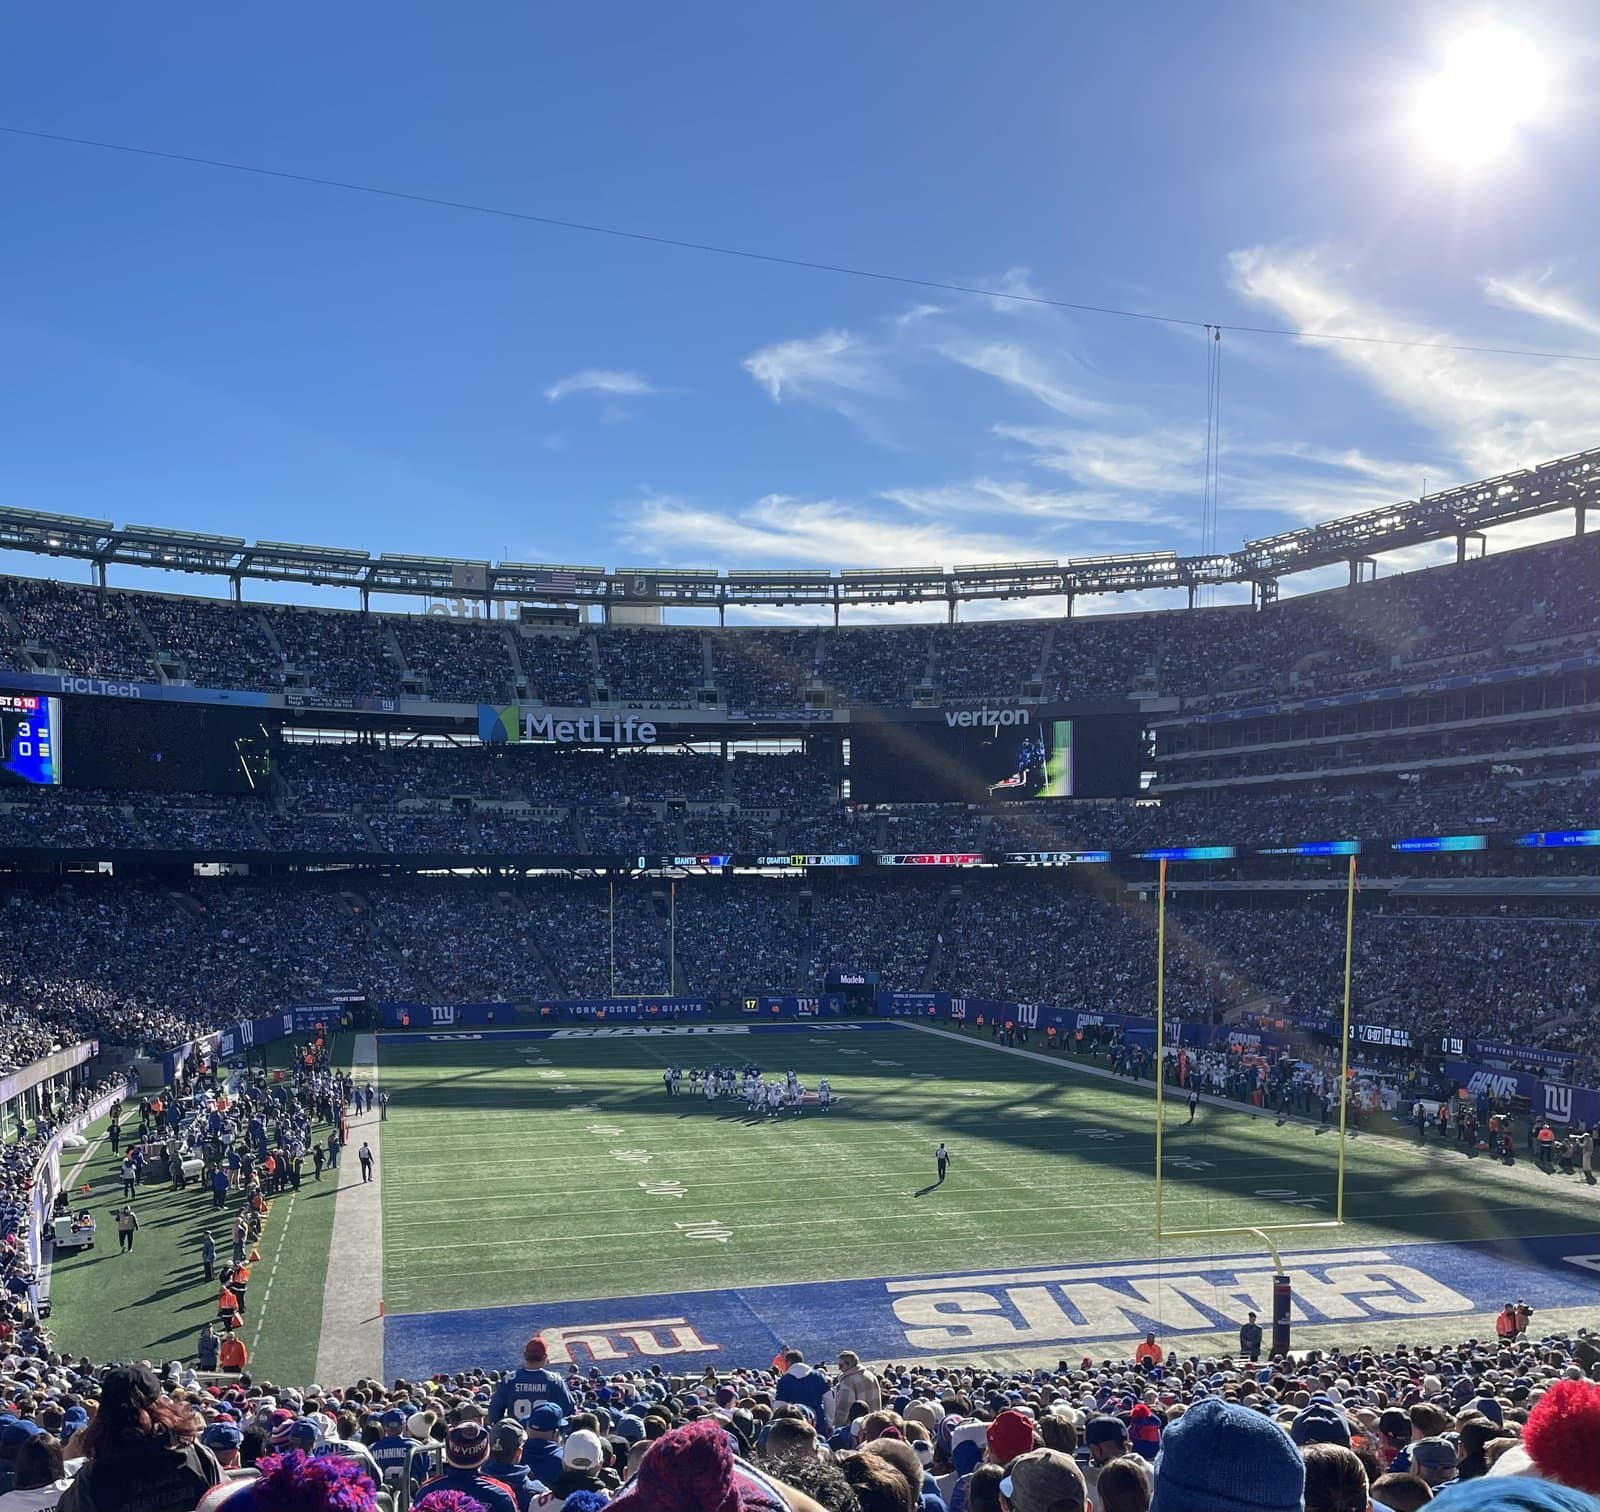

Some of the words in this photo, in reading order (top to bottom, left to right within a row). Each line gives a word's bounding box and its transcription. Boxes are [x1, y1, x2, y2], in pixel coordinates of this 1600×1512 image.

[61, 677, 140, 698] HCLTech
[23, 698, 36, 708] 10
[945, 705, 1030, 727] verizon
[18, 722, 31, 737] 3
[524, 713, 657, 744] MetLife
[19, 742, 32, 756] 0
[674, 857, 697, 865] GIANTS
[767, 857, 790, 865] QUARTER
[840, 975, 865, 984] Modelo
[745, 1001, 757, 1010] 17
[1349, 1026, 1355, 1039] 3
[1467, 1072, 1519, 1101] GIANTS
[886, 1252, 1475, 1350] GIANTS
[515, 1383, 548, 1393] STRAHAN
